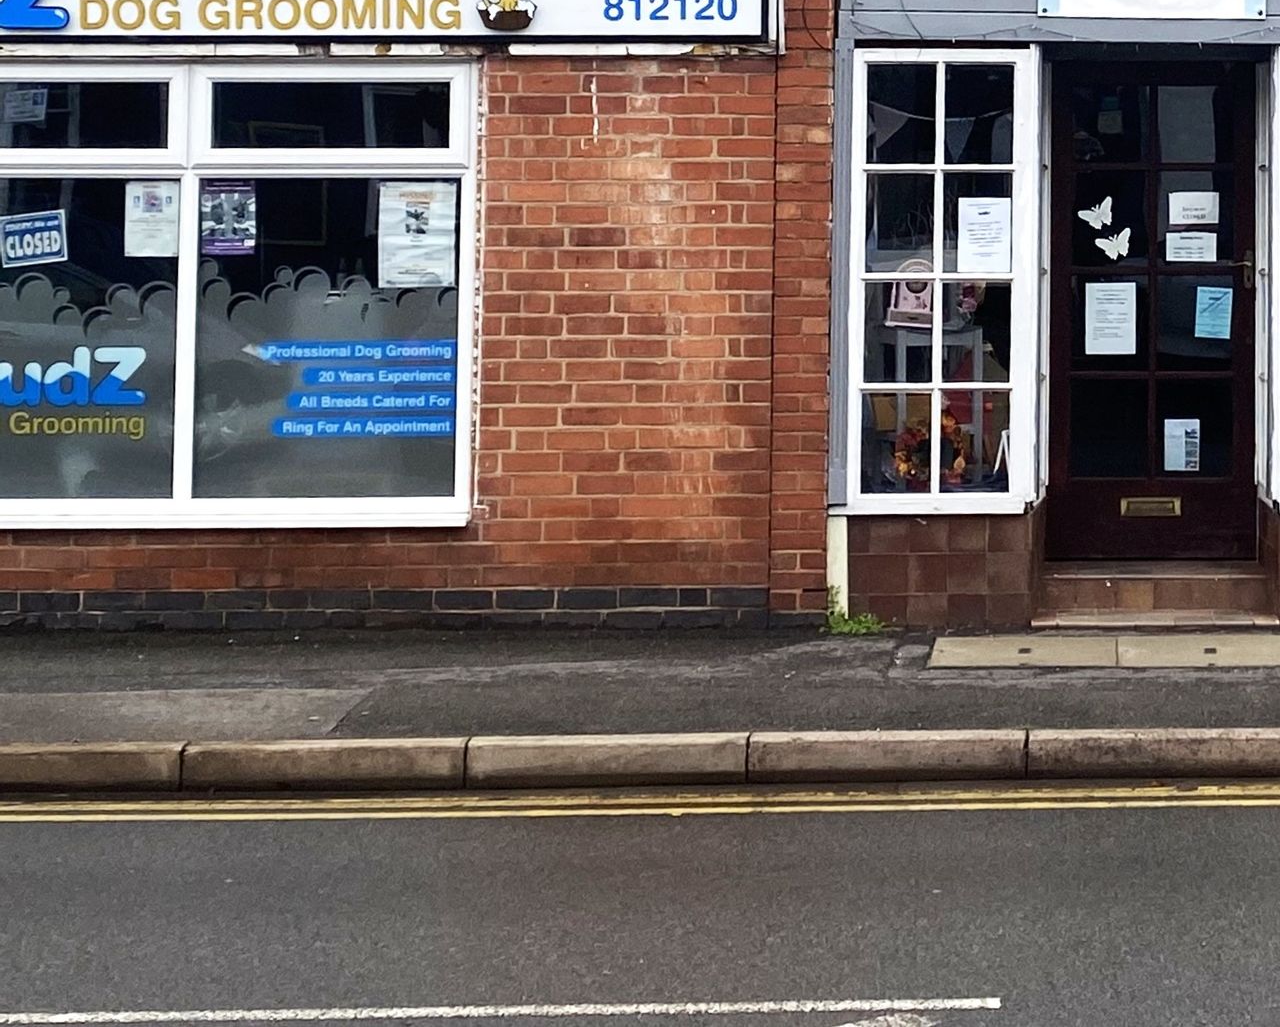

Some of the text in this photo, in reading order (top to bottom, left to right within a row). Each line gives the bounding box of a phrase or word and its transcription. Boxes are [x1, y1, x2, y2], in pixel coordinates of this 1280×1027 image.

[6, 230, 61, 259] CLOSED
[268, 344, 452, 360] Professional Dog Grooming
[318, 370, 451, 384] 20 Years Experience
[299, 394, 451, 408] All Breeds Catered For
[9, 411, 145, 441] Grooming
[282, 420, 451, 436] Ring For An Appointment
